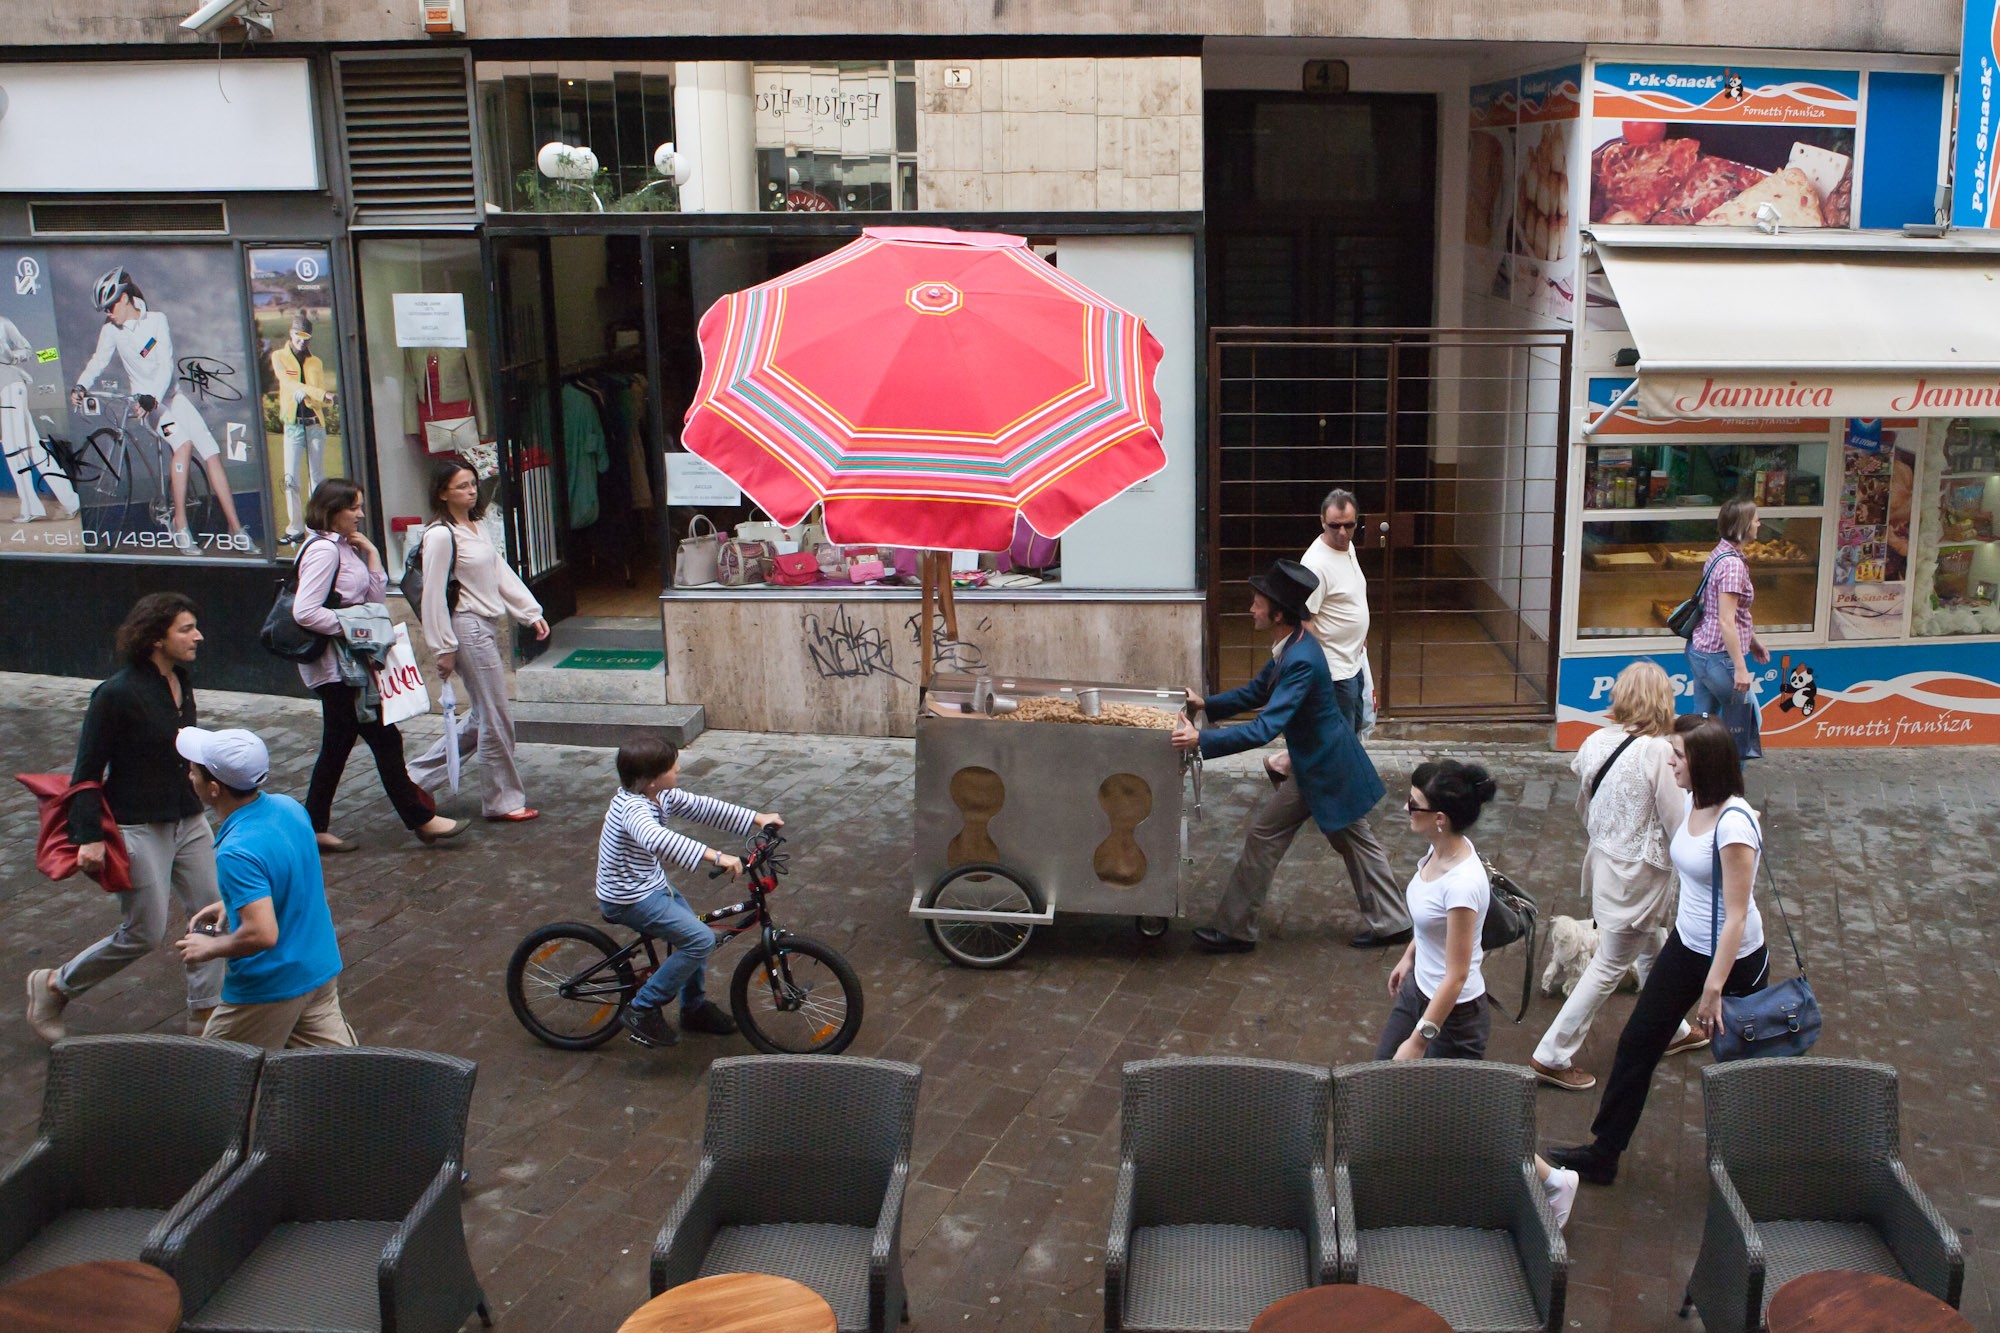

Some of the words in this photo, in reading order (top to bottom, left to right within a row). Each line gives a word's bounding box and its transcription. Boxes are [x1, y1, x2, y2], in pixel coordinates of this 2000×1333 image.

[1743, 105, 1783, 117] Fornetti
[1782, 100, 1826, 122] franšiza
[1675, 378, 1834, 412] Jamnica
[10, 529, 27, 544] 4
[1814, 717, 1891, 739] Fornetti
[1889, 709, 1973, 745] franšiza
